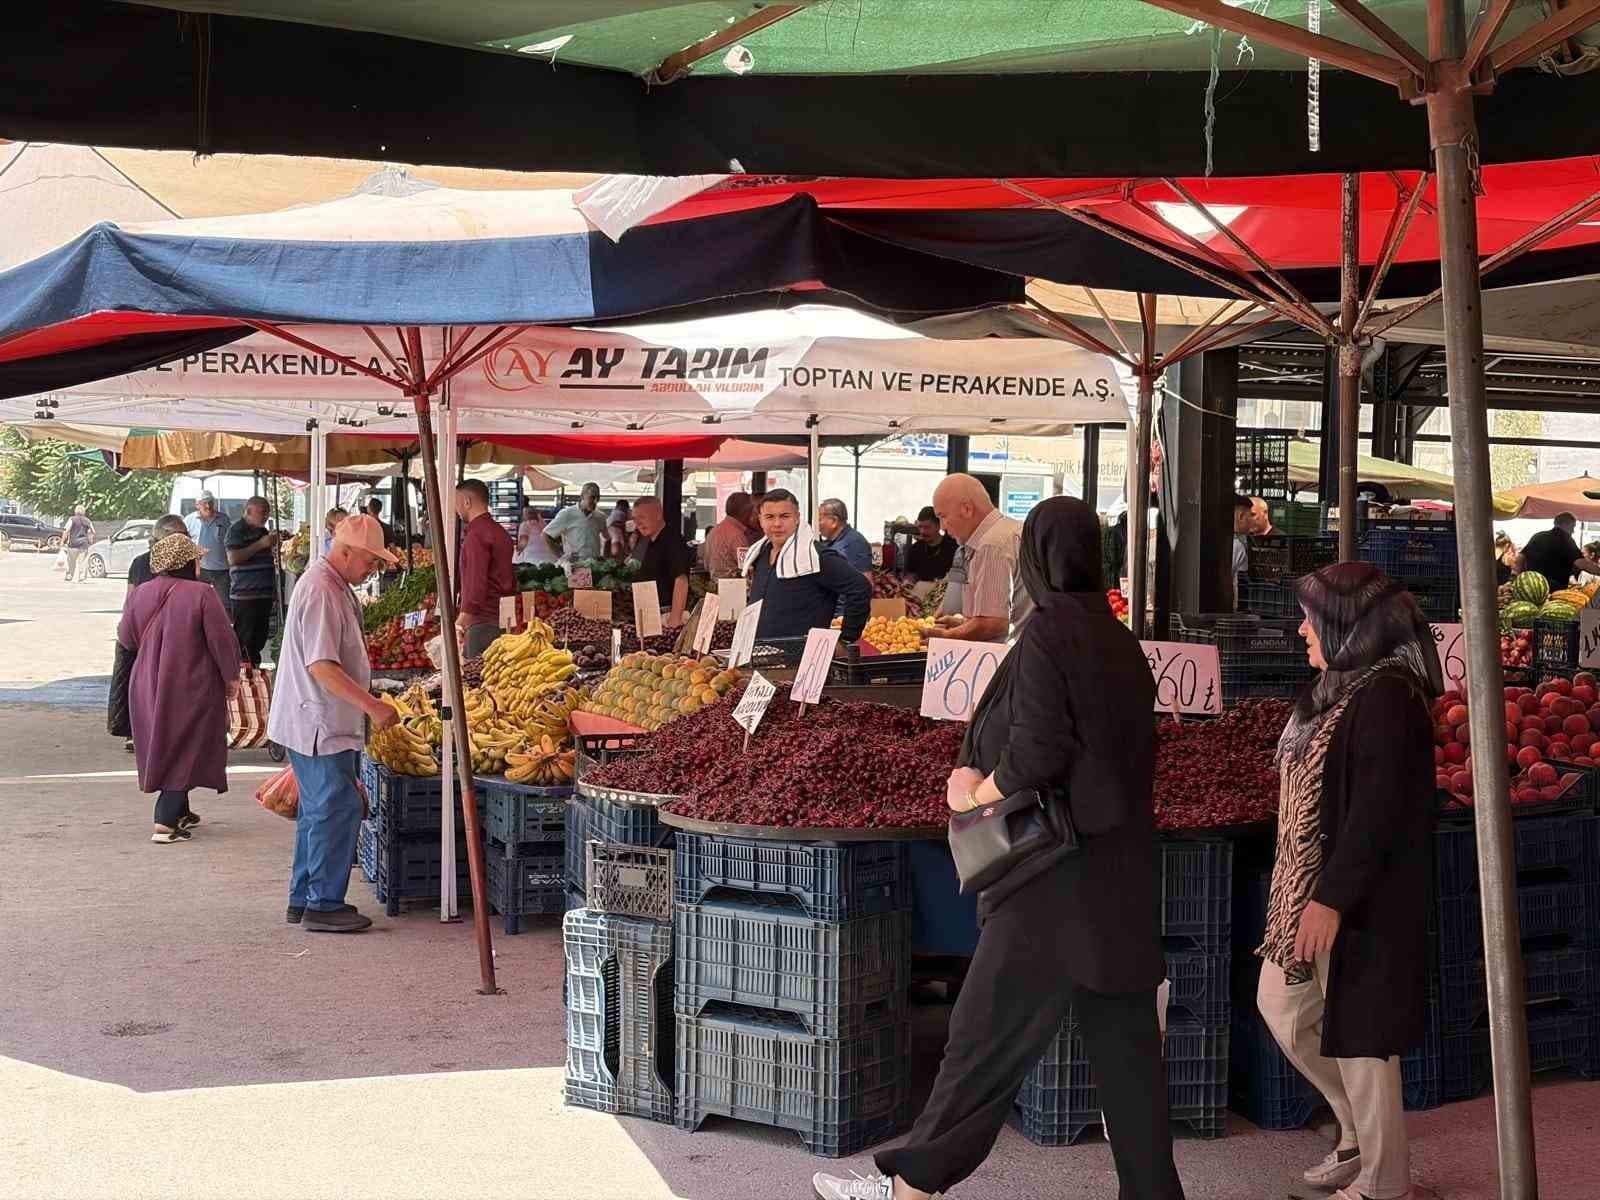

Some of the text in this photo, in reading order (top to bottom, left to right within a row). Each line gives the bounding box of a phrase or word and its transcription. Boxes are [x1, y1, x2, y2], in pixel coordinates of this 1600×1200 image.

[182, 352, 357, 376] PERAKENDE
[560, 347, 769, 378] AY TARIM
[778, 367, 1115, 402] TOPTAN VE PERAKENDE A.Ş.
[1156, 652, 1197, 706] 60
